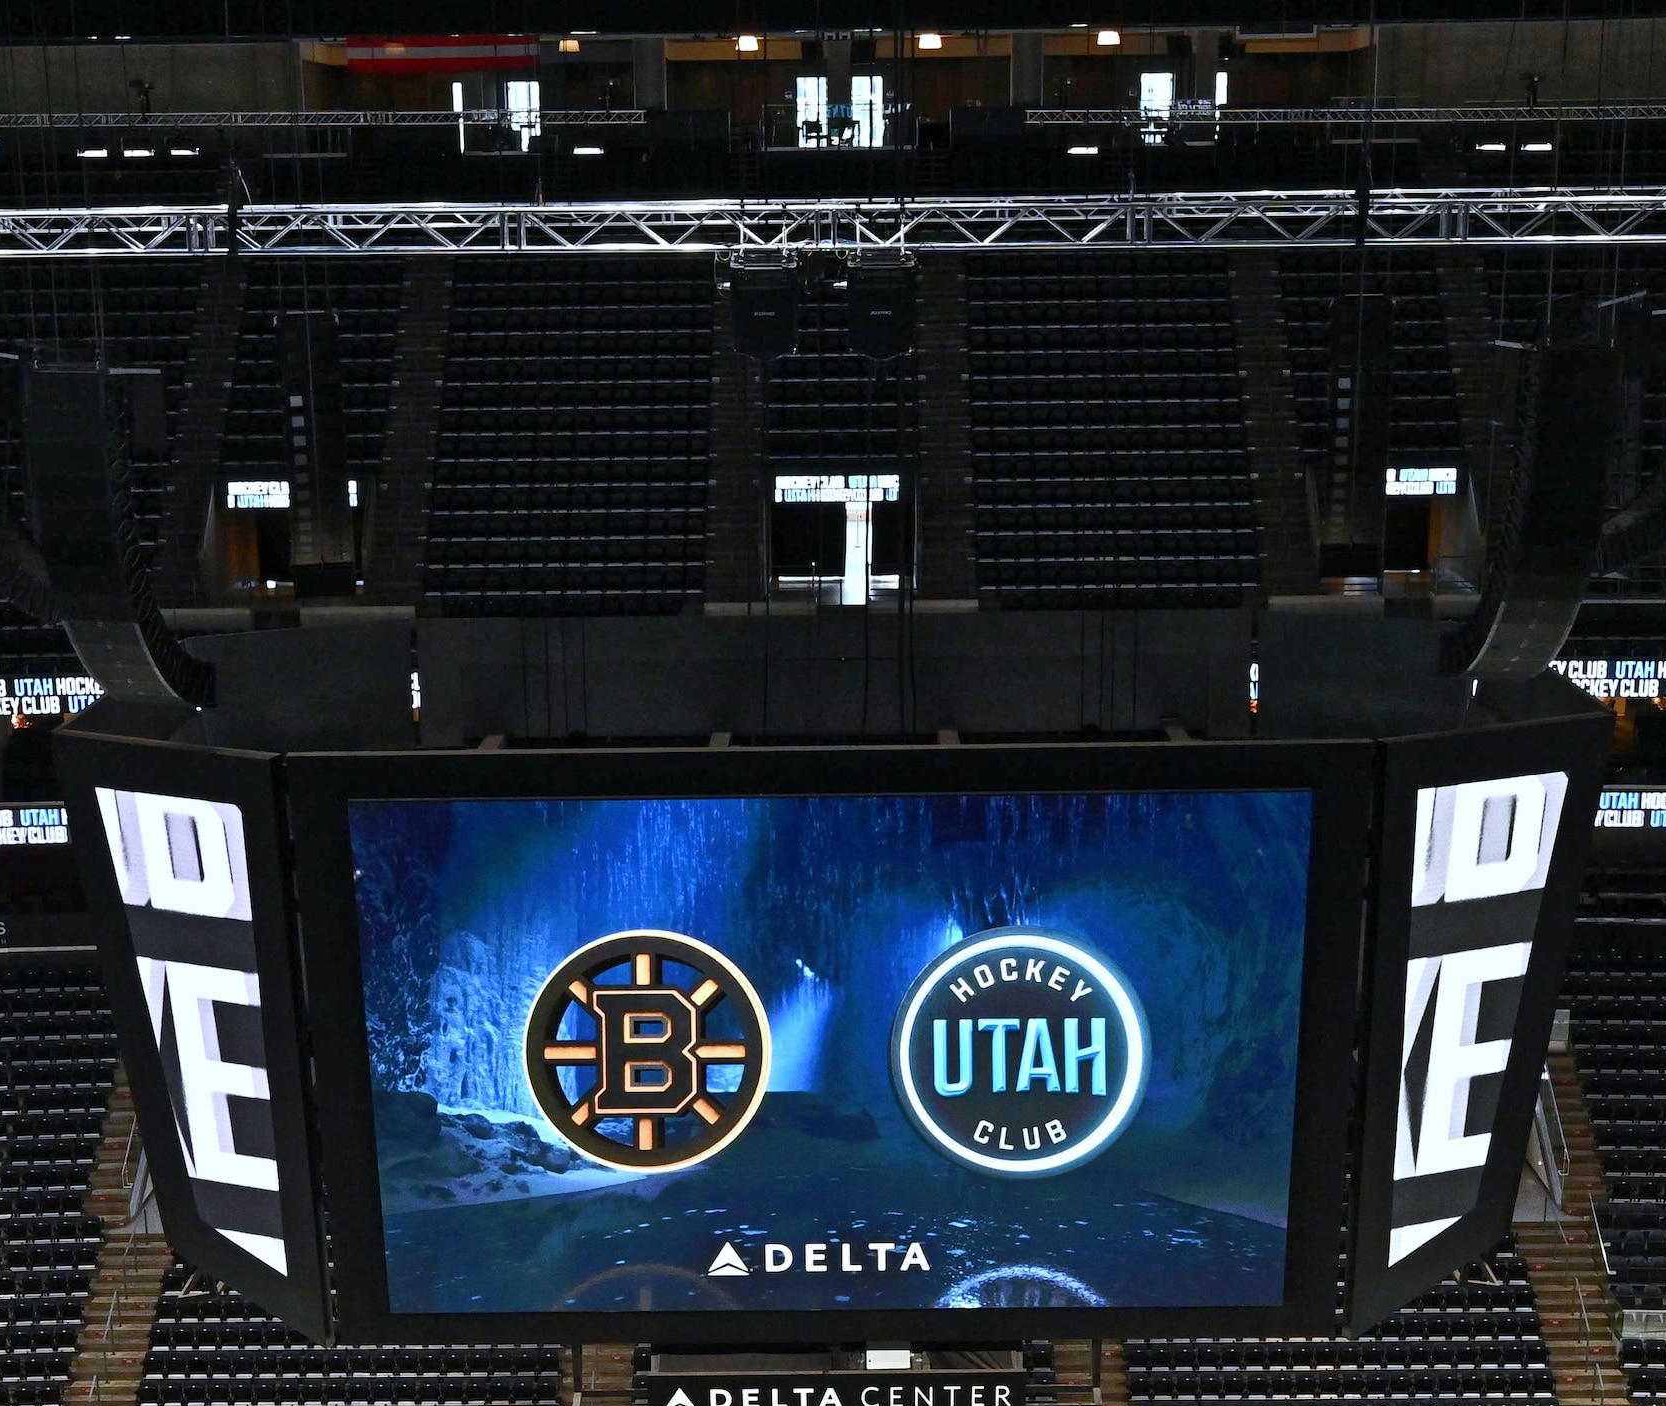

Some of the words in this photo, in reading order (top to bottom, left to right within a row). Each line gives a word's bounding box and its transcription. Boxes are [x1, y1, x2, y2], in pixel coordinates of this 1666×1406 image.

[1600, 792, 1640, 809] UTAH
[948, 957, 1093, 1004] HOCKEY
[932, 1016, 1107, 1097] UTAH
[972, 1119, 1067, 1151] CLUB
[765, 1242, 931, 1273] DELTA
